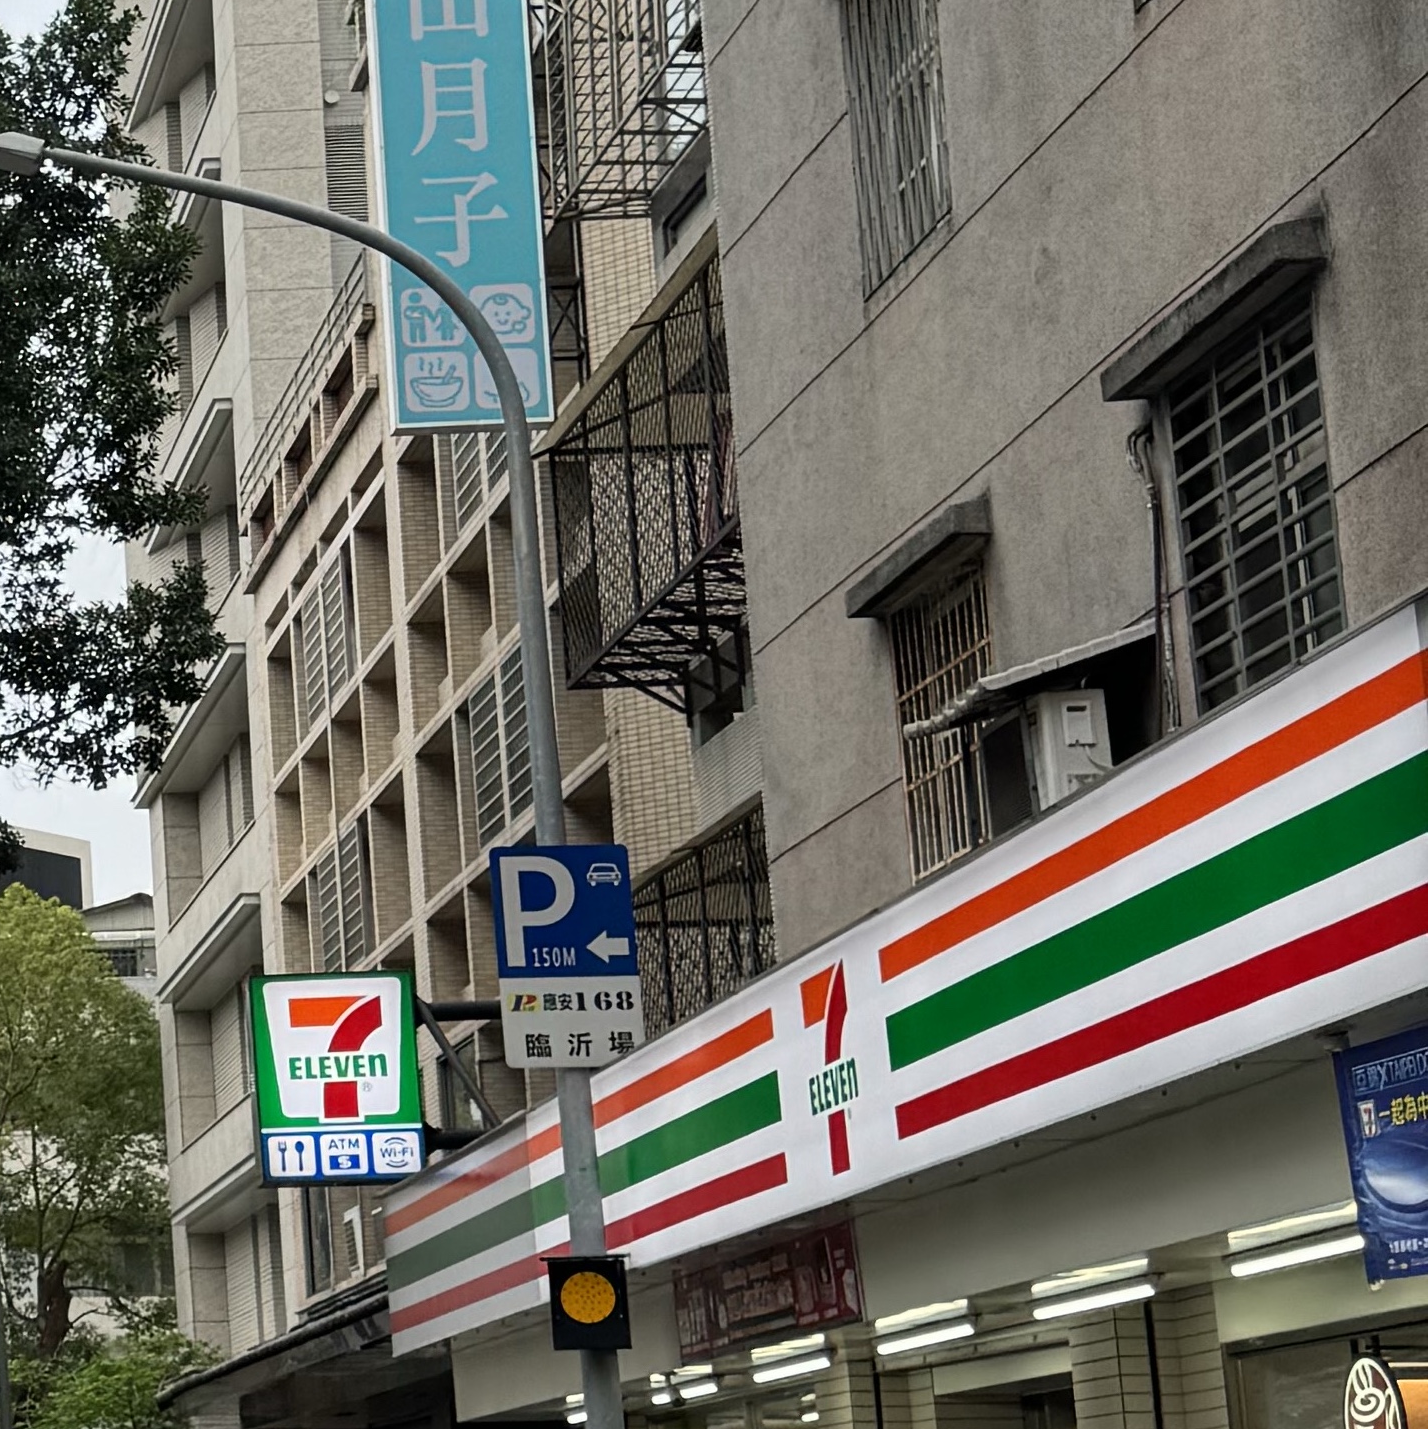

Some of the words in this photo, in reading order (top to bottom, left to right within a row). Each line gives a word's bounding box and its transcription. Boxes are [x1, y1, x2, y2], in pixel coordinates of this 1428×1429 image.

[499, 855, 575, 967] P
[532, 947, 576, 967] 150M
[525, 1030, 635, 1058] 臨沂場
[328, 1138, 360, 1150] ATM
